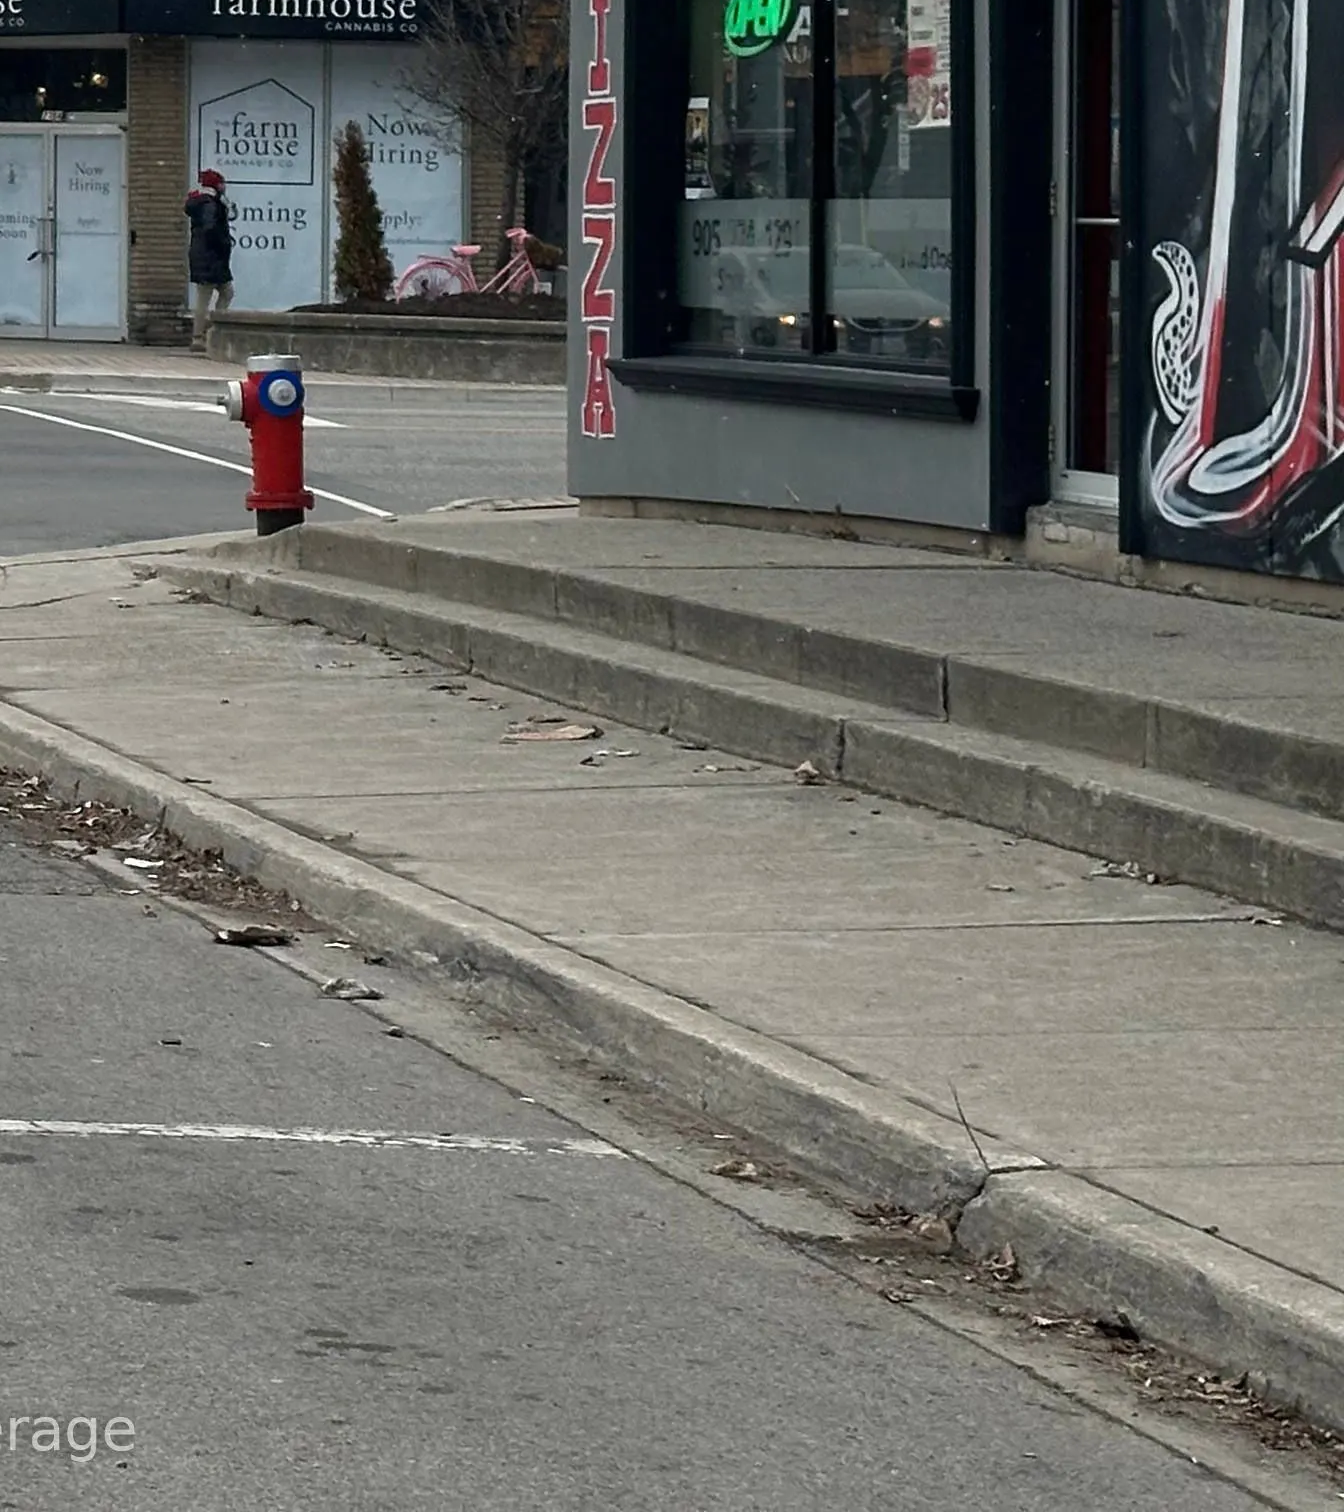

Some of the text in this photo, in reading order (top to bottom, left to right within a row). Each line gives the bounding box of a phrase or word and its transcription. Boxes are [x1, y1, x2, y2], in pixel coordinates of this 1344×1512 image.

[8, 17, 25, 28] CO
[325, 21, 419, 33] CANNABIS CO
[232, 111, 298, 139] farm
[215, 129, 300, 157] house
[74, 161, 104, 177] Now
[68, 178, 111, 196] Hiring
[227, 200, 308, 231] oming
[692, 219, 722, 256] 905
